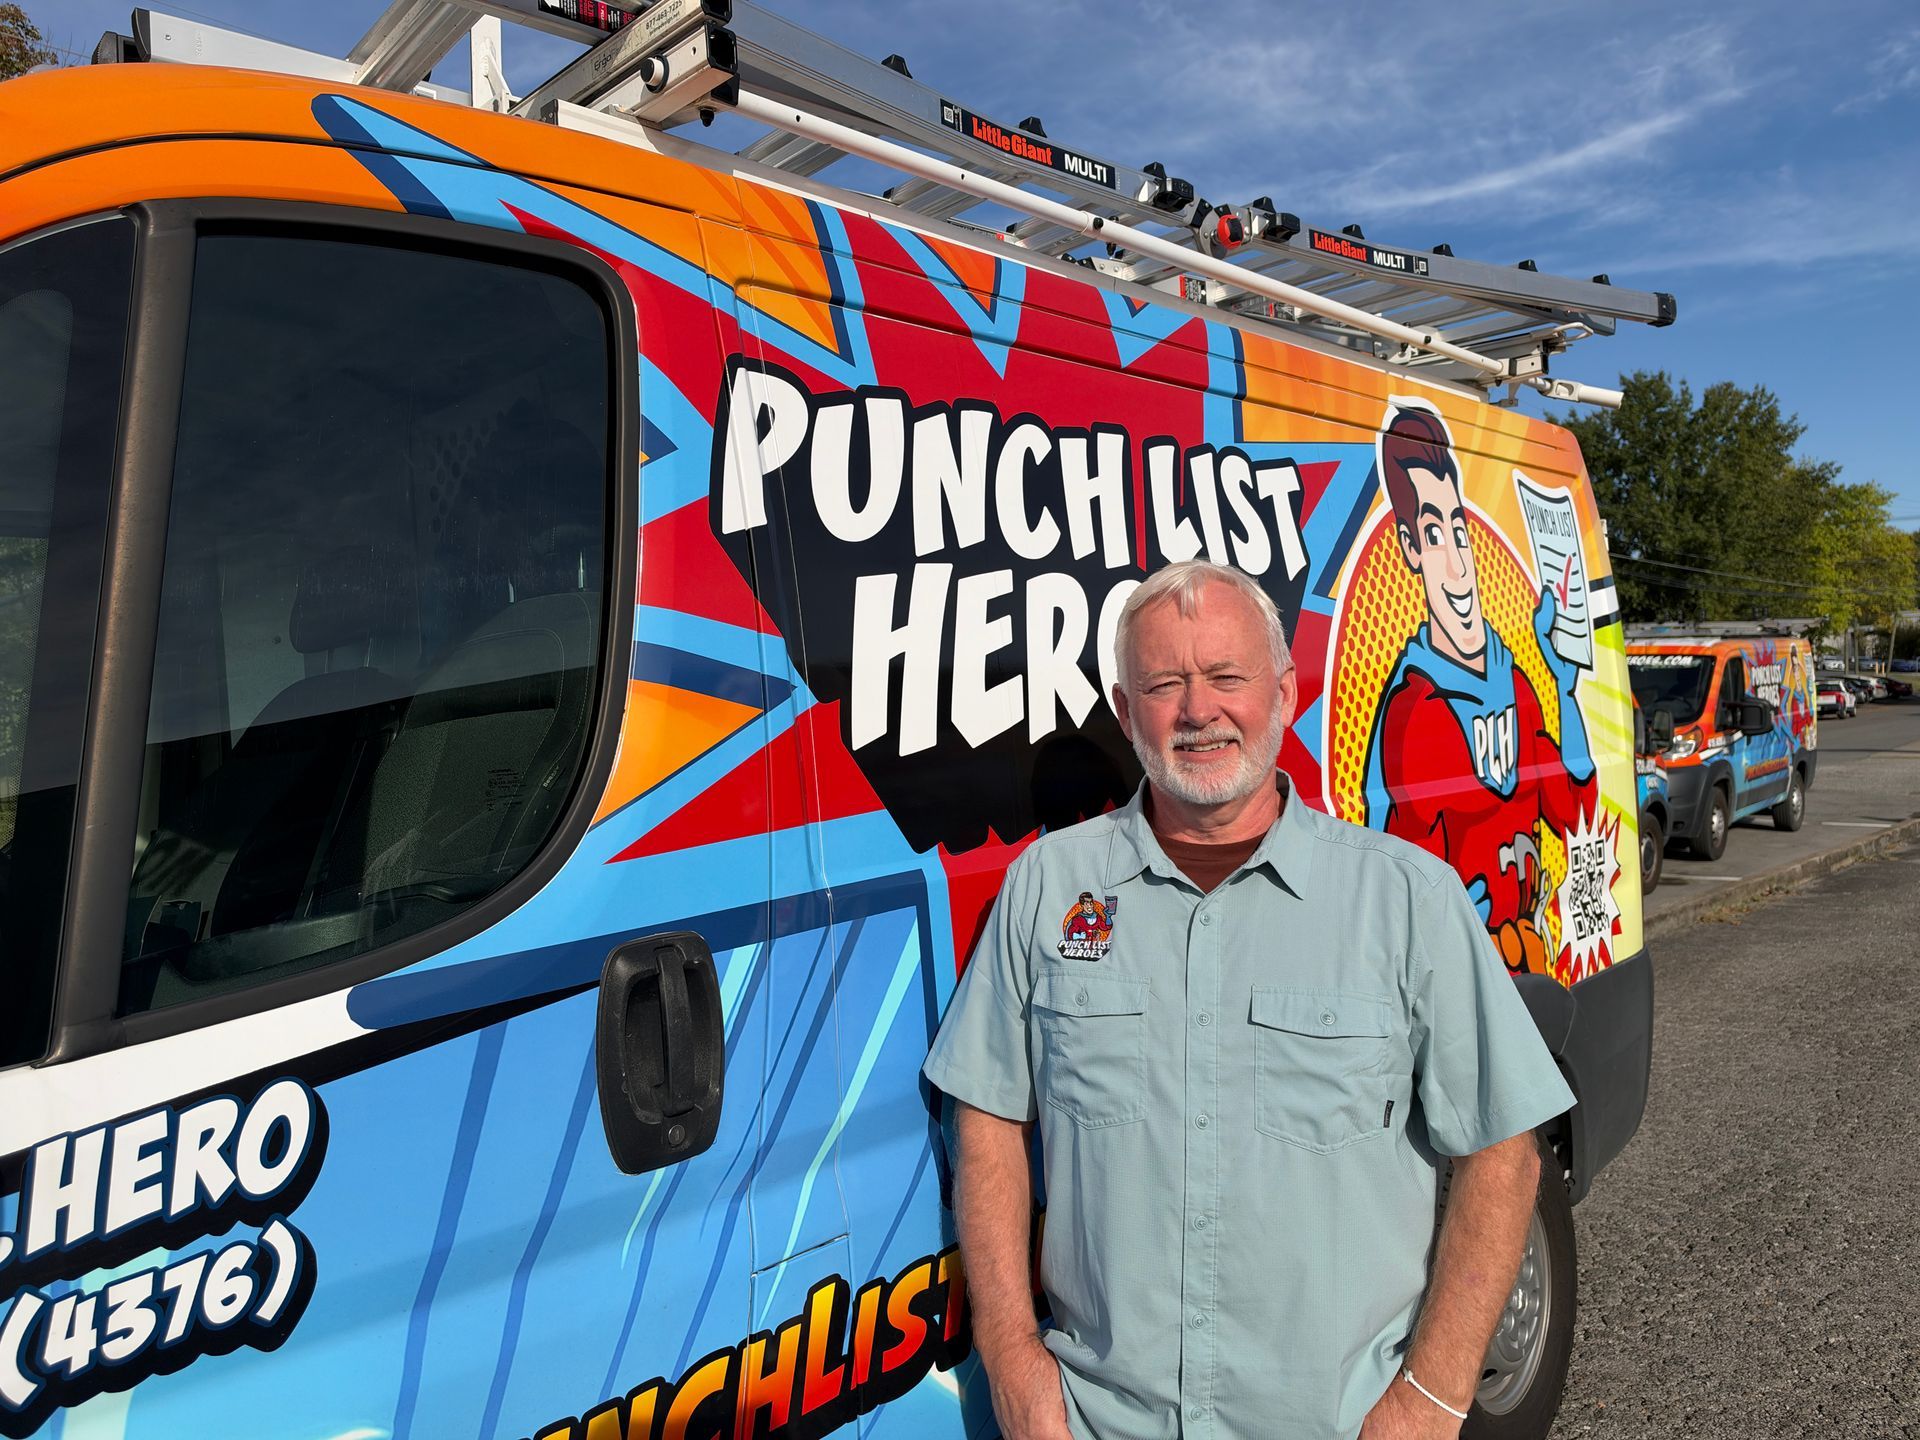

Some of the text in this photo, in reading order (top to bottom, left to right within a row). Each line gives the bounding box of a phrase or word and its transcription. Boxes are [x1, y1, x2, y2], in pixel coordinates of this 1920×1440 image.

[594, 54, 612, 71] Ergo
[972, 116, 1010, 151] Little
[1011, 134, 1053, 166] Giant
[1064, 153, 1107, 184] MULTI
[1313, 232, 1340, 255] Little
[1341, 240, 1367, 262] Giant
[1373, 250, 1405, 270] MULTI
[722, 366, 1307, 582] PUNCH LIST
[1526, 499, 1575, 539] PUNCH LIST
[1472, 704, 1516, 787] PLH
[1058, 940, 1112, 950] PUNCH LIST
[1063, 948, 1103, 959] HEROES
